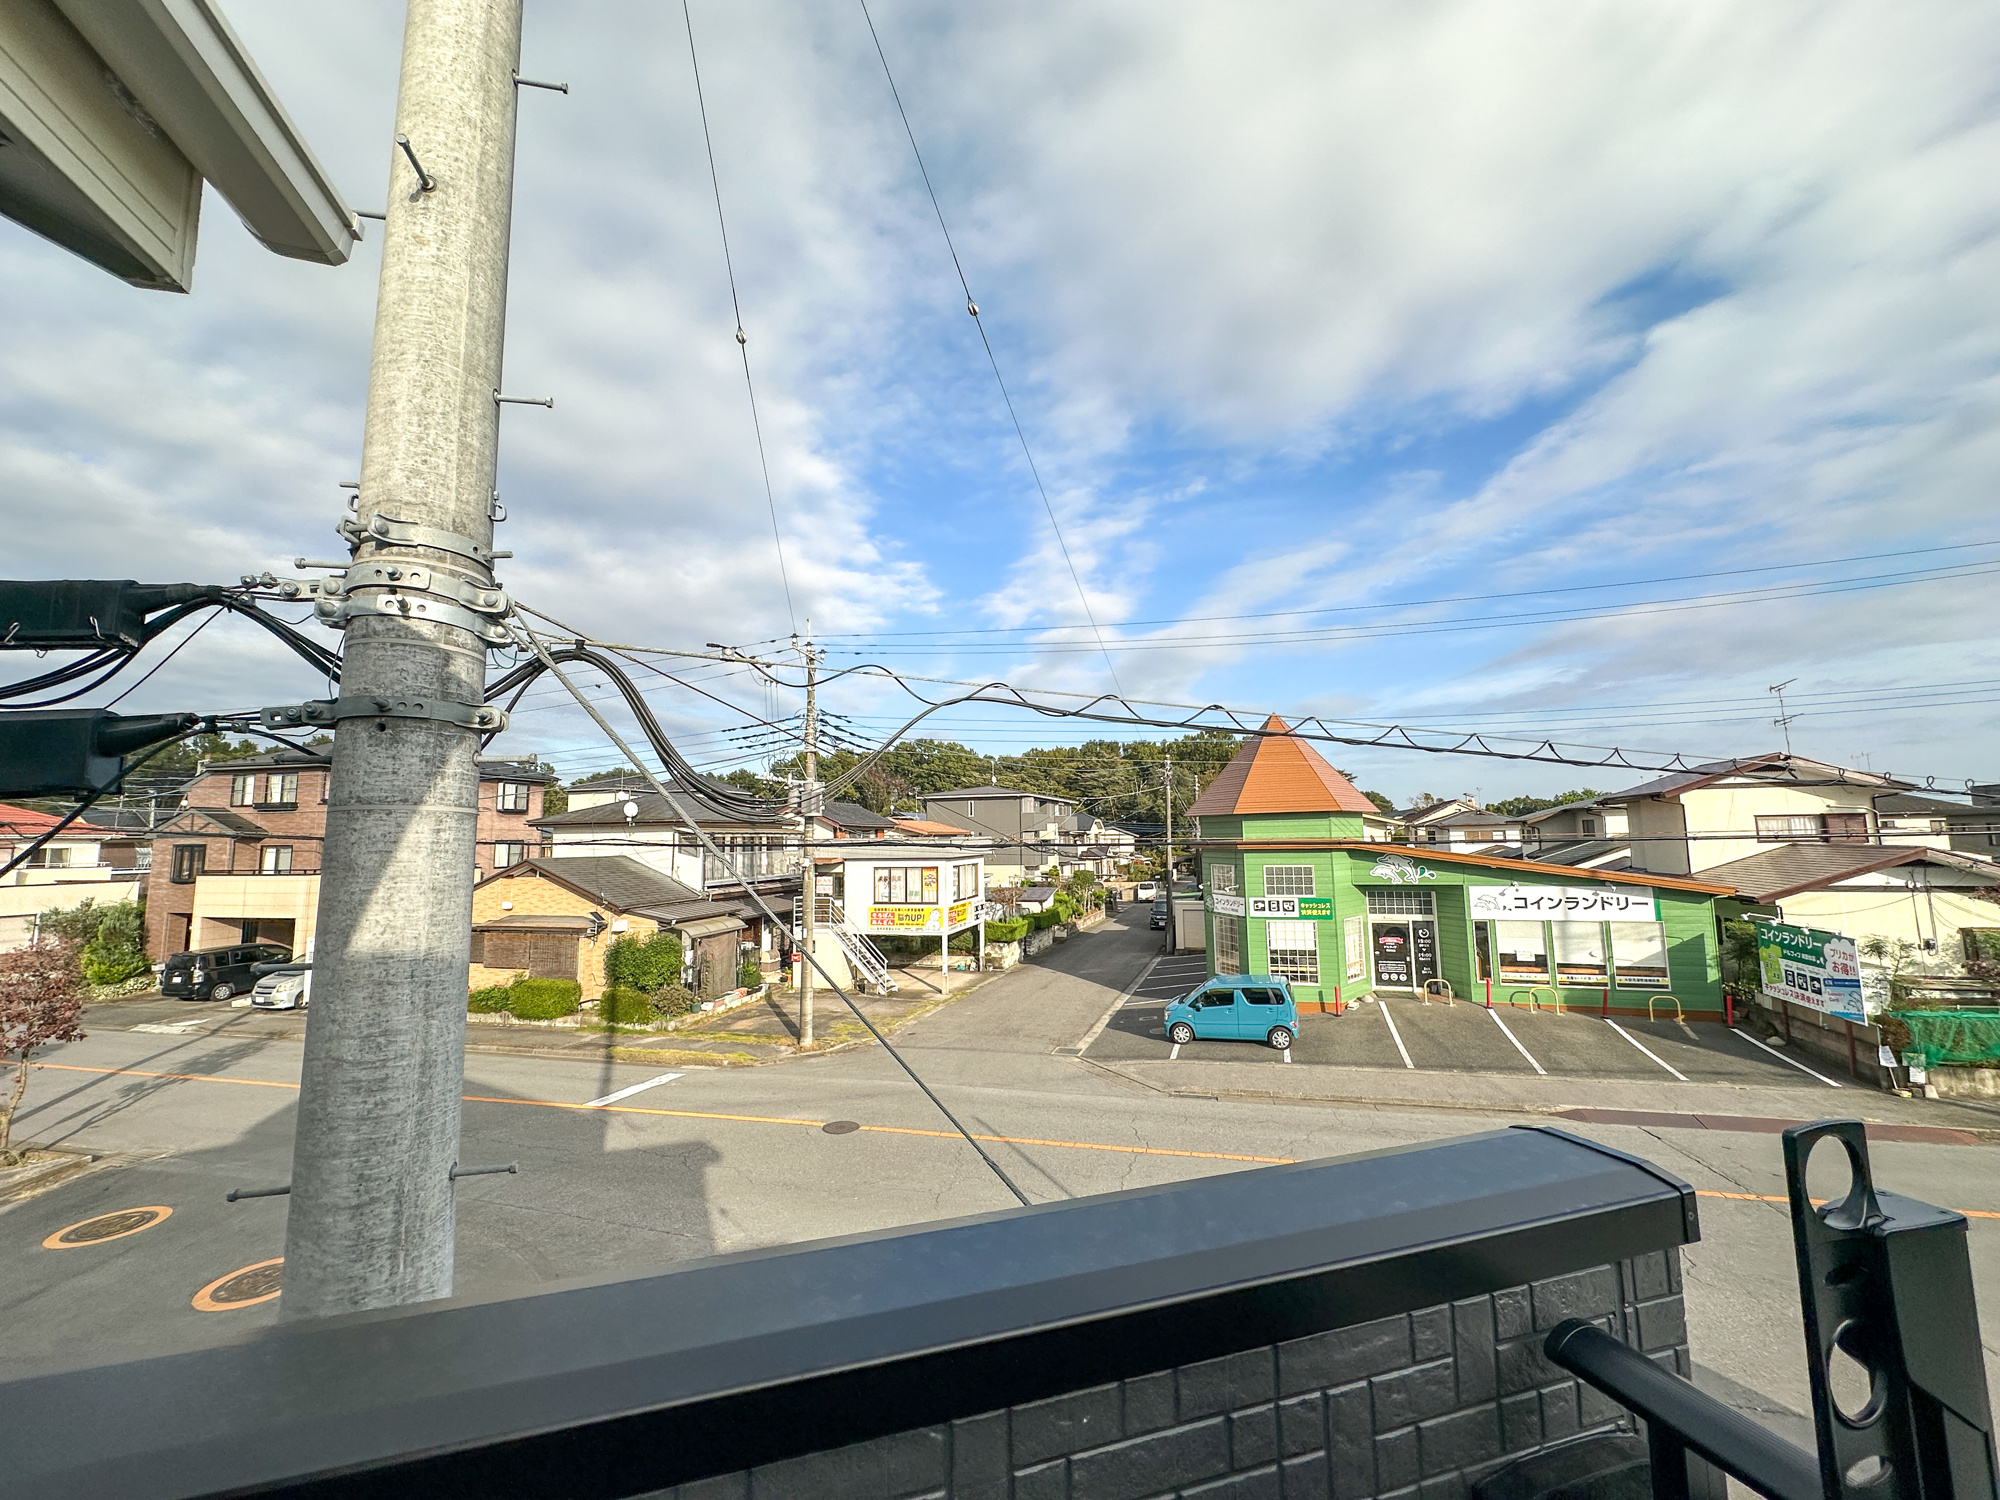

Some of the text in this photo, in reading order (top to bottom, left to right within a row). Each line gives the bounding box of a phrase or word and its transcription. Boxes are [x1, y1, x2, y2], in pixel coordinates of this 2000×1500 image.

[1514, 896, 1649, 911] コインランドリー
[1760, 928, 1822, 949] コインランドリー
